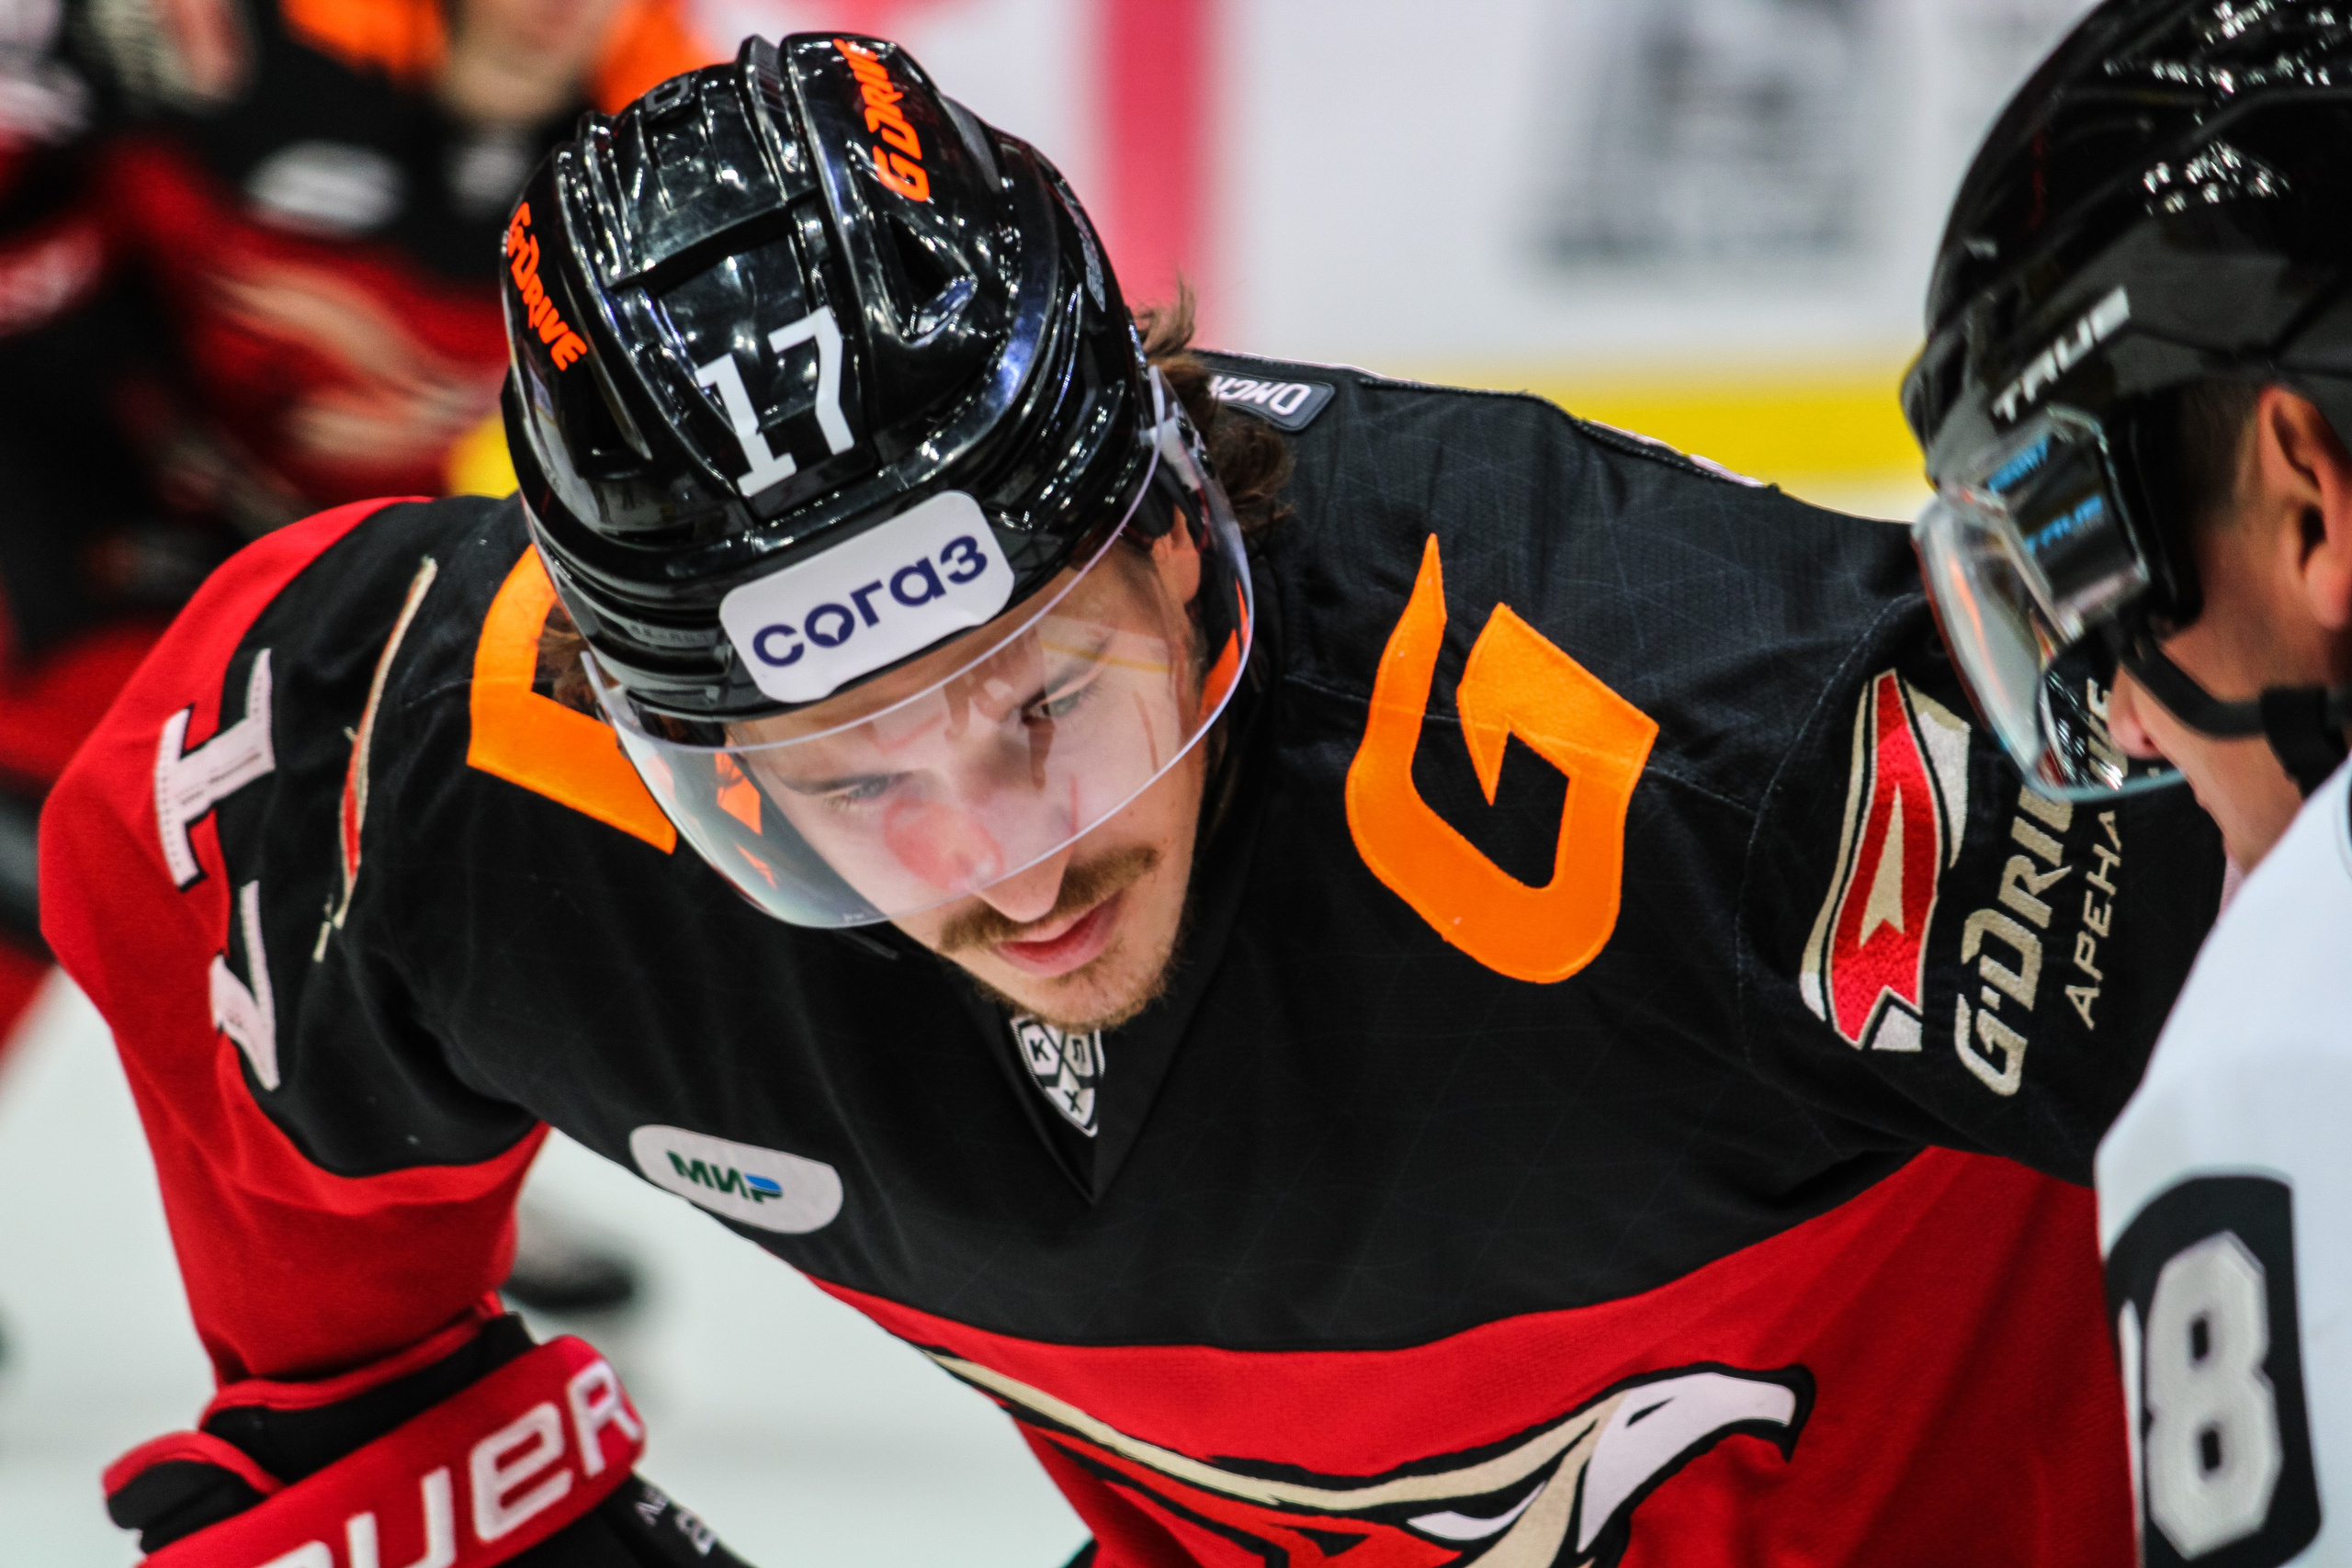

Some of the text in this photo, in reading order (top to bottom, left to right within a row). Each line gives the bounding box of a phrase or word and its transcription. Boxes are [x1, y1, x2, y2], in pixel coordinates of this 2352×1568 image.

[695, 306, 854, 497] 17
[1992, 285, 2131, 424] TRUE
[752, 534, 989, 669] согаз
[1344, 532, 1659, 984] G
[665, 1148, 784, 1204] МИР
